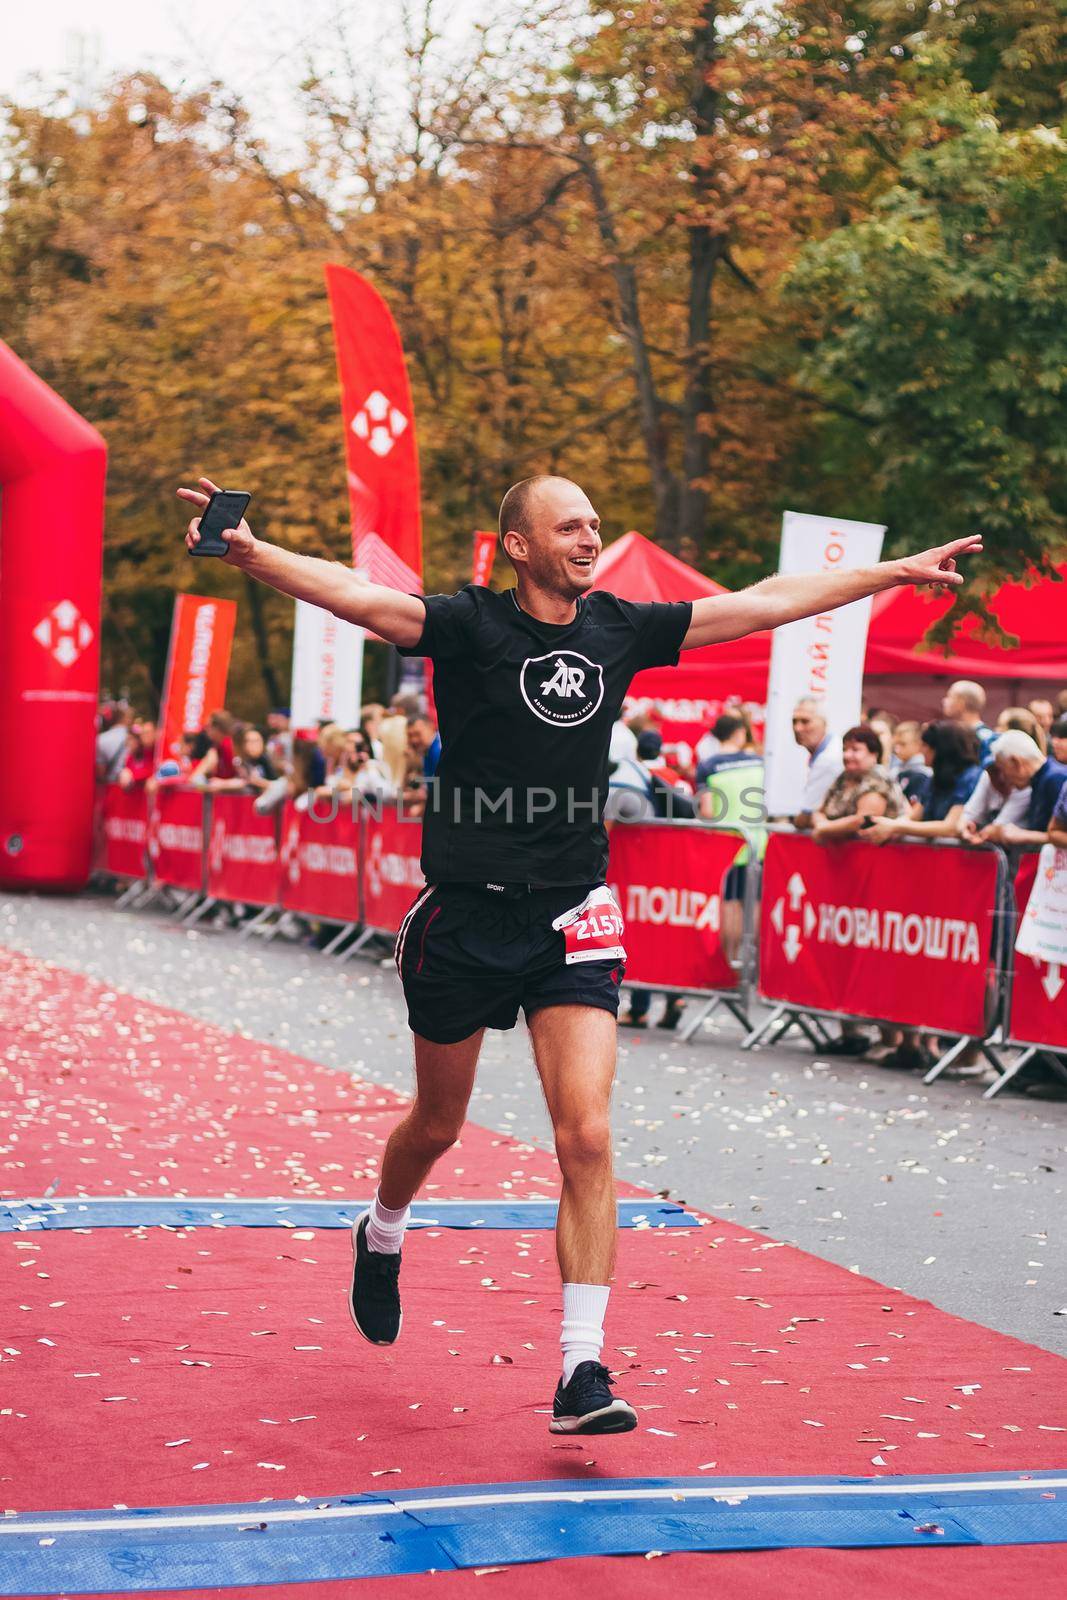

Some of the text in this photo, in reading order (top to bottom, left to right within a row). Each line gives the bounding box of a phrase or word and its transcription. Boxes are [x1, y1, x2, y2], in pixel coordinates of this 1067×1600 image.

[486, 883, 505, 892] SPORT
[626, 886, 720, 932] ПОШТА
[818, 902, 980, 965] НОВА ПОШТА
